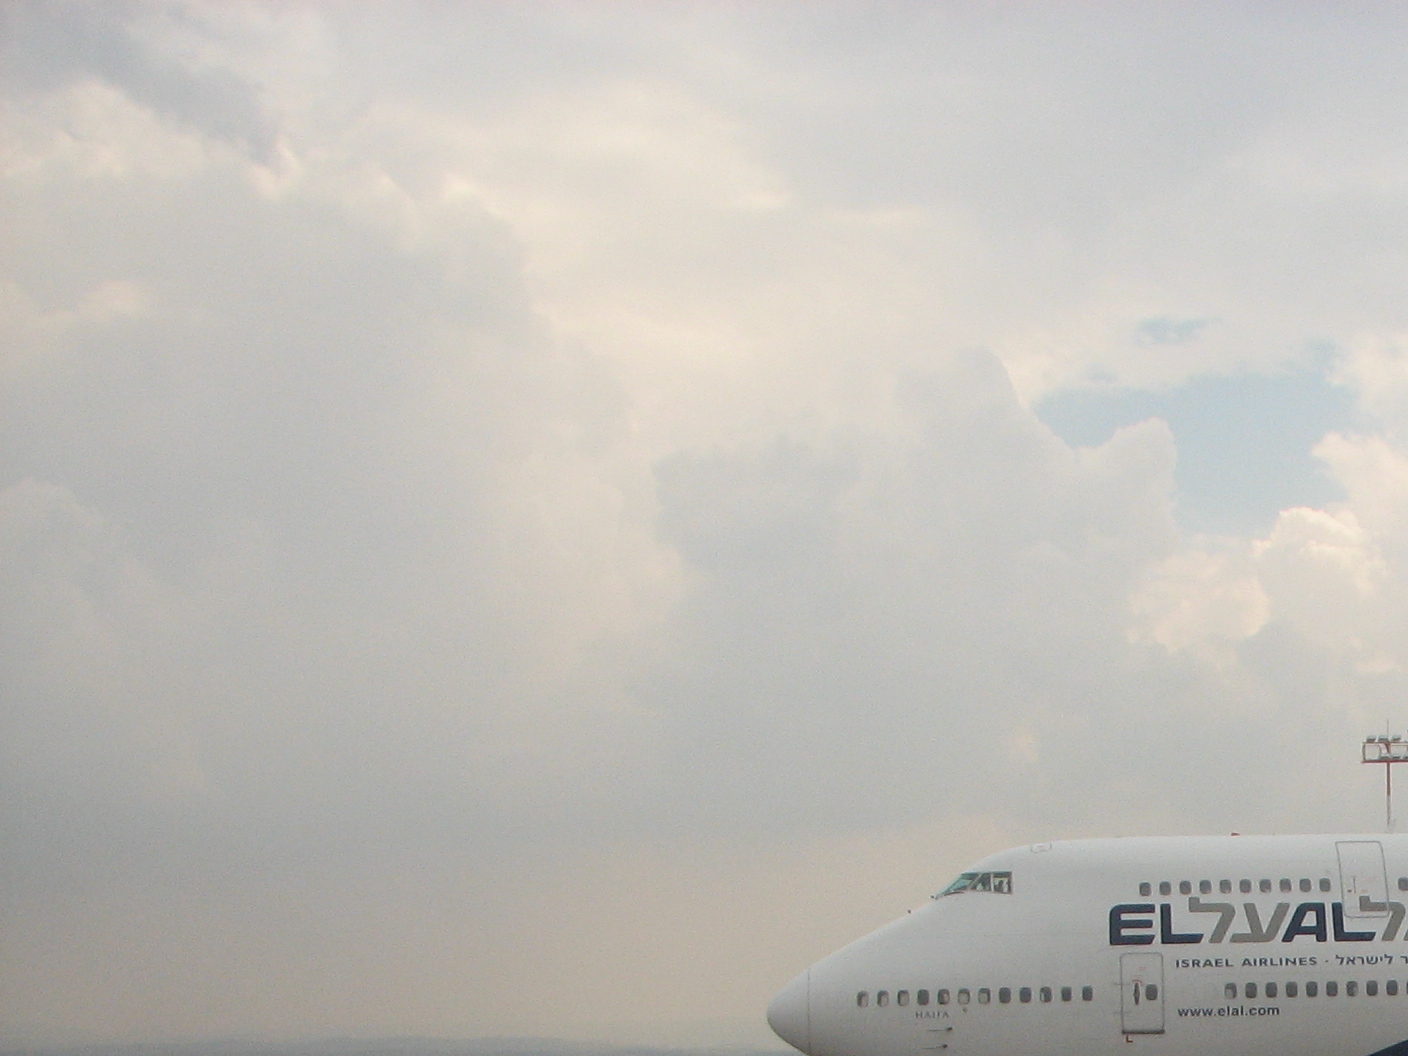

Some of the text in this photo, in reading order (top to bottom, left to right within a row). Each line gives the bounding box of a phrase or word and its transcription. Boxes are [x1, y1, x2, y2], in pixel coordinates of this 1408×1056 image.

[1175, 956, 1318, 968] ISRAEL AIRLINES
[1335, 954, 1394, 965] לישראל
[1177, 1006, 1280, 1017] www.elal.com
